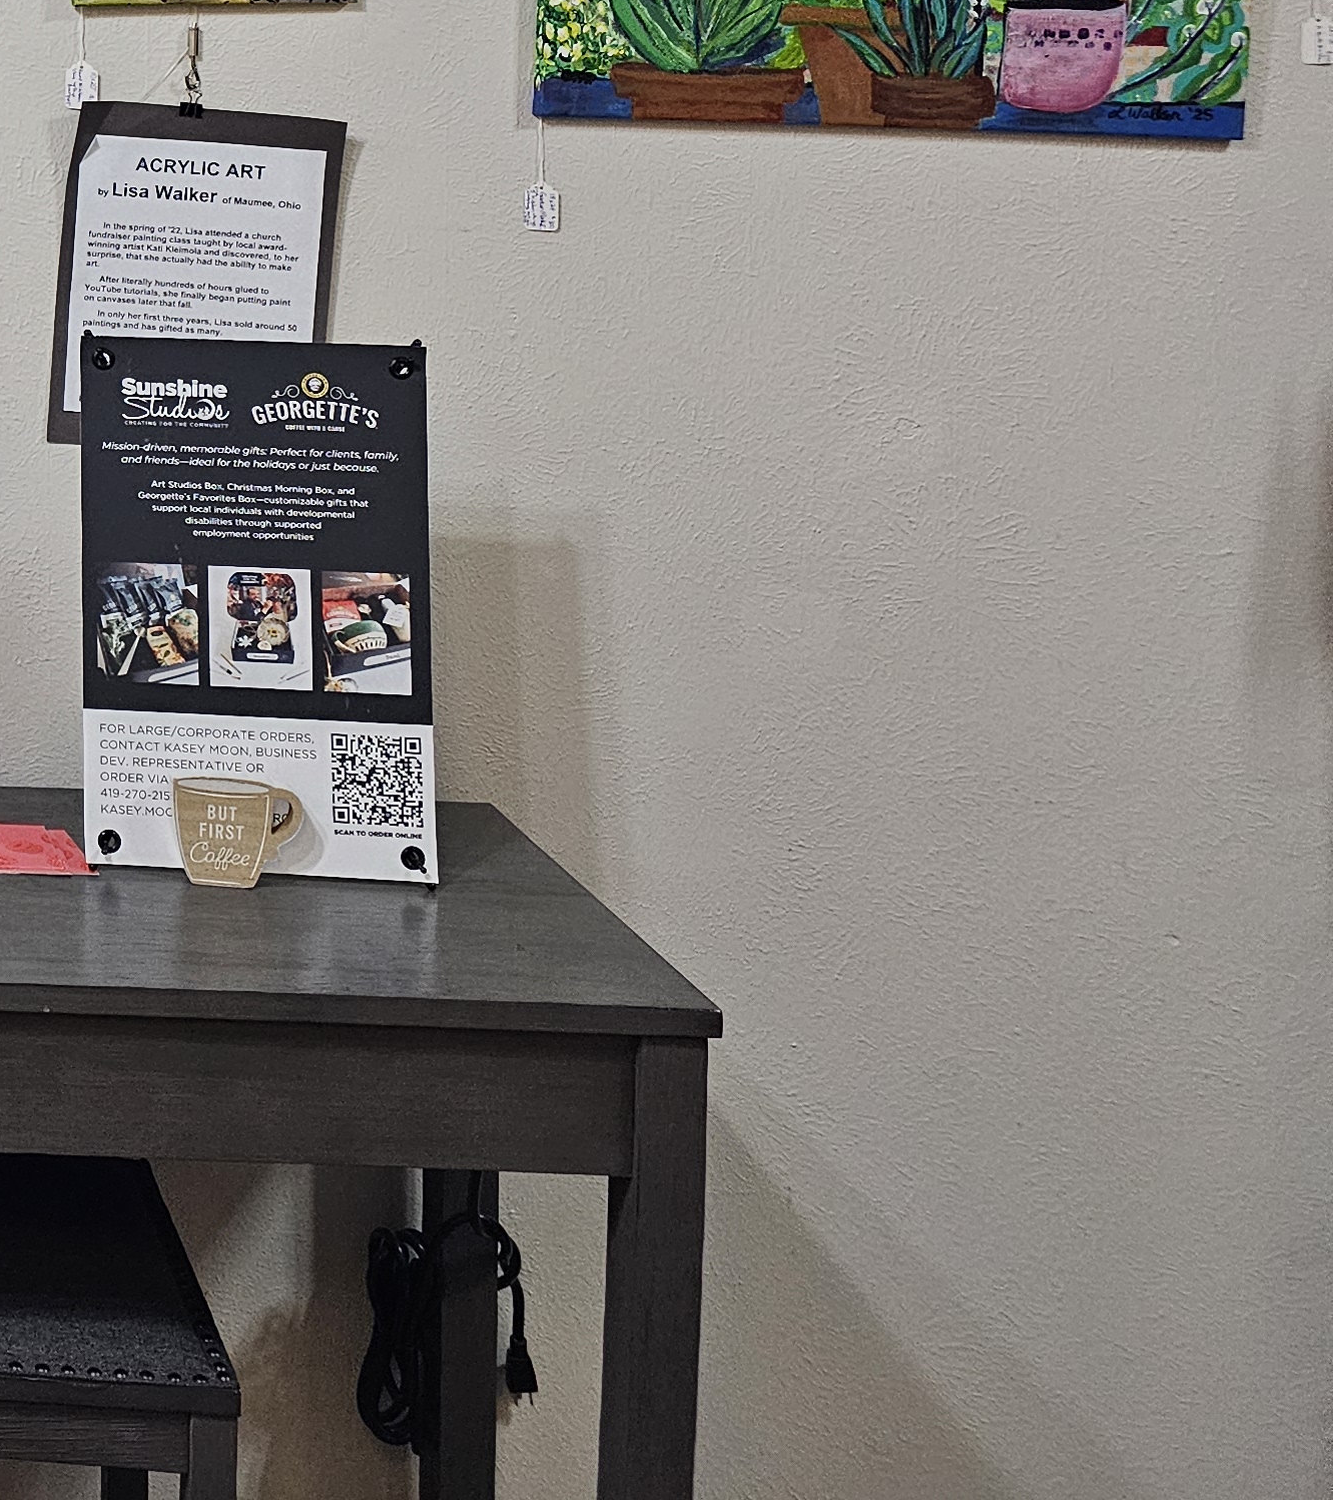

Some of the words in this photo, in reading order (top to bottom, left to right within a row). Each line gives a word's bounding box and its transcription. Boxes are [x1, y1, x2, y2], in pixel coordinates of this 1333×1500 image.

[135, 157, 219, 176] ACRYLIC
[225, 162, 266, 179] ART
[98, 188, 109, 196] by
[113, 182, 149, 198] Lisa
[155, 184, 218, 203] Walker
[222, 196, 232, 204] of
[234, 197, 276, 209] Maumee,
[279, 200, 301, 210] Ohio
[113, 222, 126, 230] the
[128, 224, 155, 234] spring
[185, 227, 203, 236] Lisa
[205, 229, 242, 238] attended
[251, 232, 281, 241] church
[97, 310, 105, 318] In
[107, 311, 125, 321] only
[127, 312, 141, 320] her
[143, 314, 160, 322] first
[162, 315, 183, 323] three
[186, 318, 211, 327] years,
[214, 319, 231, 327] Lisa
[234, 320, 253, 328] sold
[255, 322, 285, 331] around
[287, 324, 297, 332] 50
[121, 377, 228, 398] Sunshine
[251, 399, 380, 430] GEORGETTE'S
[101, 442, 178, 453] Mission-driven,
[179, 444, 240, 454] memorable
[269, 448, 306, 457] Perfect
[308, 449, 323, 457] for
[324, 450, 361, 460] clients,
[363, 451, 399, 462] family,
[120, 455, 142, 463] and
[143, 456, 214, 466] friends—ideal
[216, 458, 231, 466] for
[232, 459, 250, 467] the
[252, 459, 296, 471] holidays
[311, 462, 330, 472] just
[333, 462, 380, 472] because.
[151, 480, 165, 488] Art
[167, 481, 202, 490] Studios
[204, 482, 224, 491] Box,
[227, 483, 272, 492] Christmas
[274, 484, 313, 495] Morning
[315, 486, 335, 495] Box,
[337, 487, 355, 495] and
[137, 492, 191, 503] Georgette's
[193, 494, 235, 503] Favorites
[237, 495, 325, 506] Box—customizable
[326, 498, 347, 508] gifts
[349, 499, 368, 507] that
[151, 503, 187, 514] support
[189, 505, 211, 513] local
[213, 506, 262, 515] individuals
[264, 508, 284, 516] with
[286, 508, 355, 520] developmental
[184, 516, 233, 526] disabilities
[235, 518, 271, 529] through
[274, 520, 321, 531] supported
[192, 529, 250, 540] employment
[252, 531, 314, 542] opportunities
[99, 724, 125, 735] FOR
[129, 725, 255, 740] LARGE/CORPORATE
[259, 730, 314, 744] ORDERS,
[99, 739, 159, 752] CONTACT
[164, 742, 205, 754] KASEY
[209, 744, 251, 757] MOON,
[255, 746, 317, 759] BUSINESS
[100, 756, 128, 767] DEV.
[132, 757, 241, 772] REPRESENTATIVE
[246, 762, 264, 773] OR
[99, 772, 143, 784] ORDER
[147, 774, 169, 785] VIA
[100, 789, 171, 800] 419-270-215
[207, 805, 237, 821] BUT
[199, 822, 244, 840] FIRST
[395, 832, 422, 840] ONLINE
[190, 842, 250, 870] Coffee
